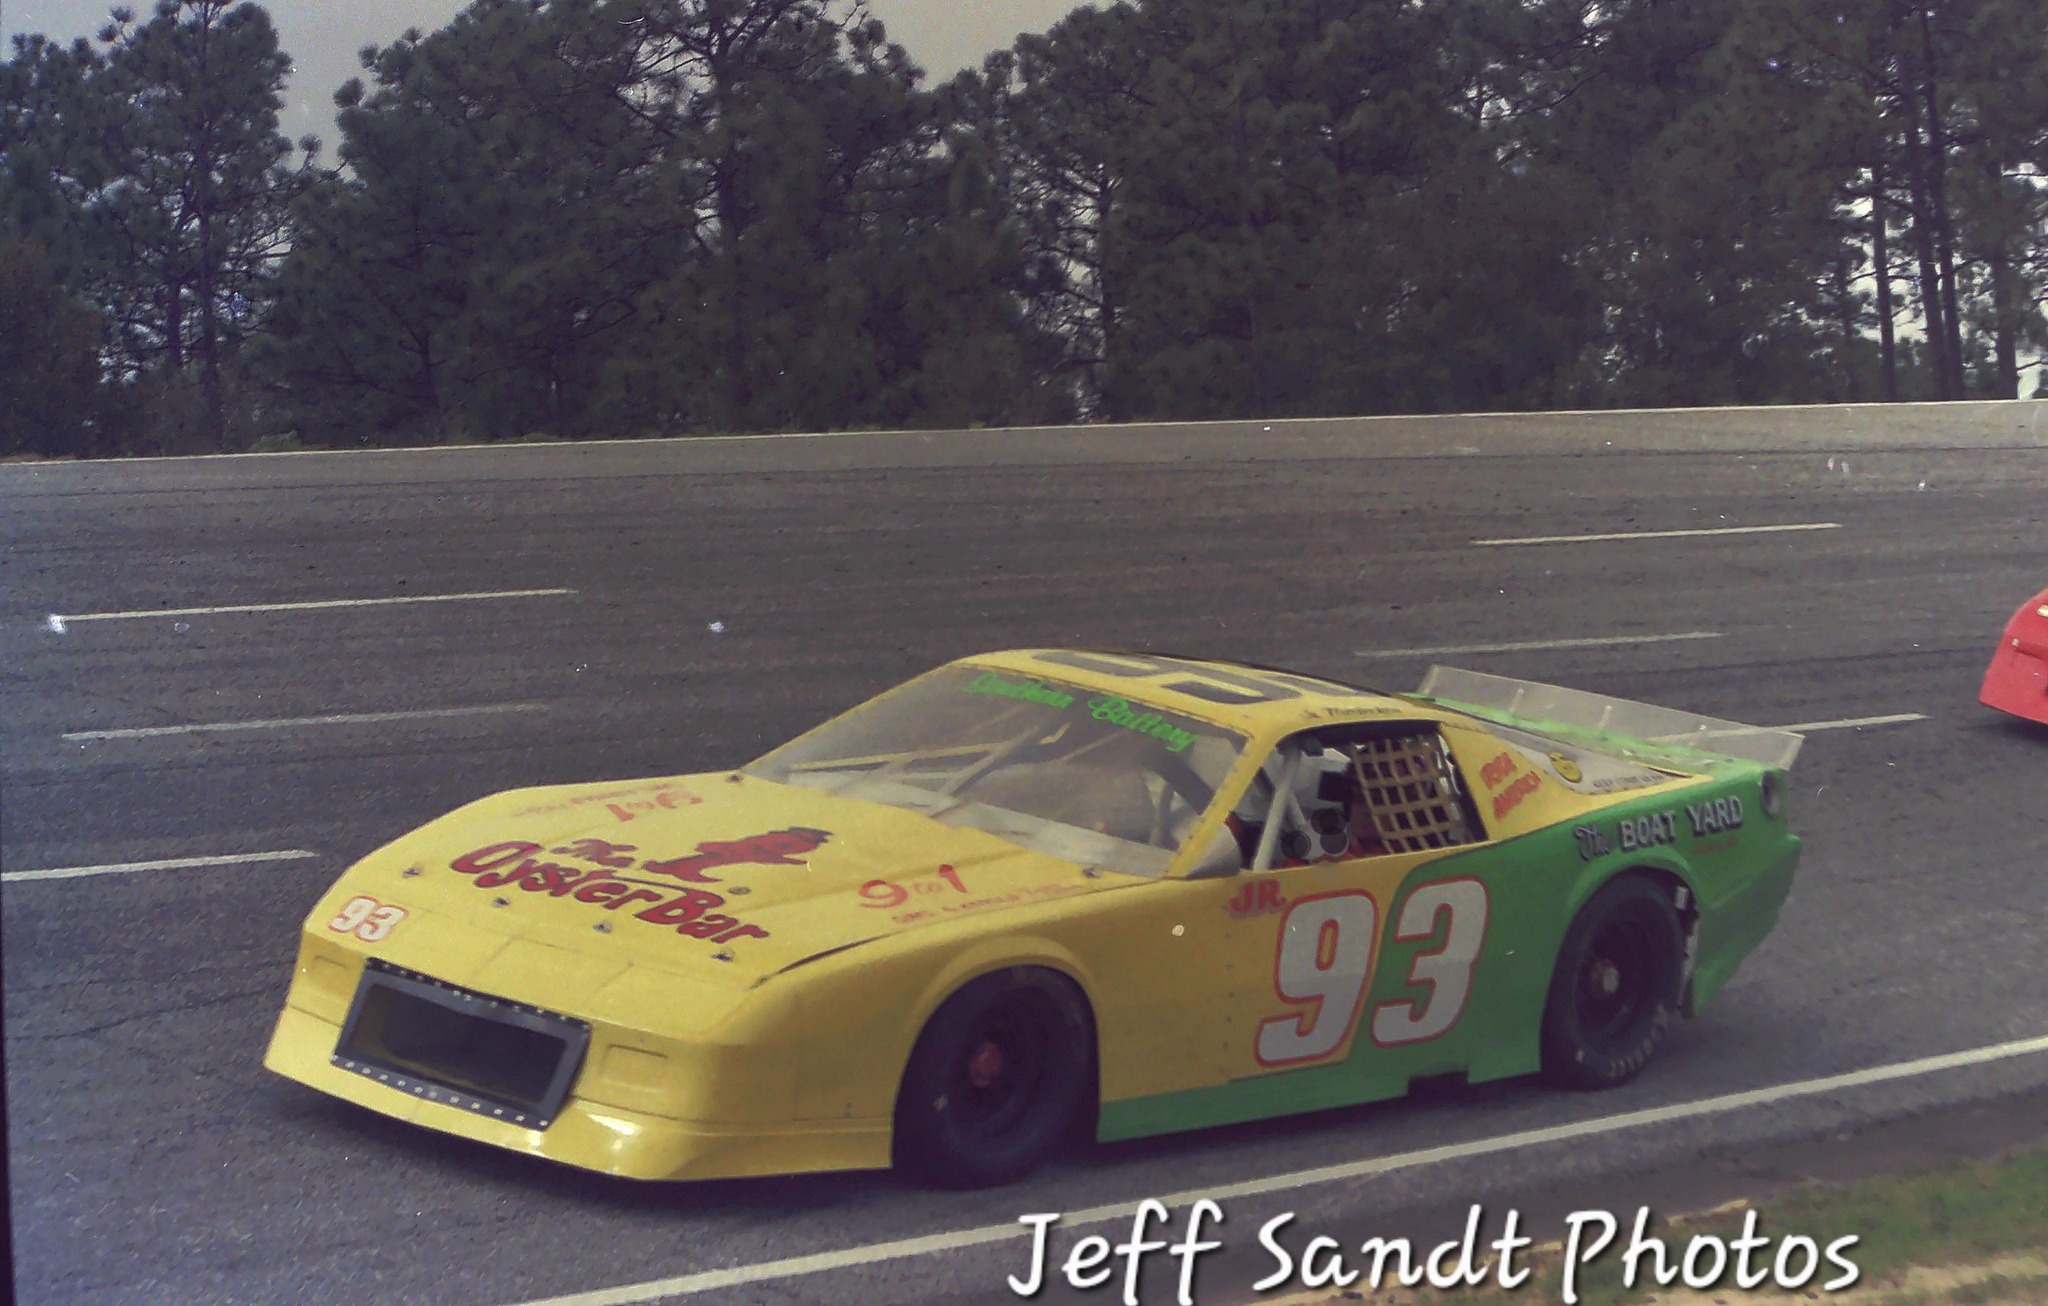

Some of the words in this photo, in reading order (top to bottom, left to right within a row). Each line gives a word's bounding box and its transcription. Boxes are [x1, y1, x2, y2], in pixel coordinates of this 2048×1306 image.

[1618, 810, 1676, 853] BOAT
[1684, 795, 1743, 836] YARD
[327, 895, 409, 943] 93
[449, 840, 663, 910] Oyster
[633, 887, 770, 944] Bar
[1254, 875, 1490, 1067] 93
